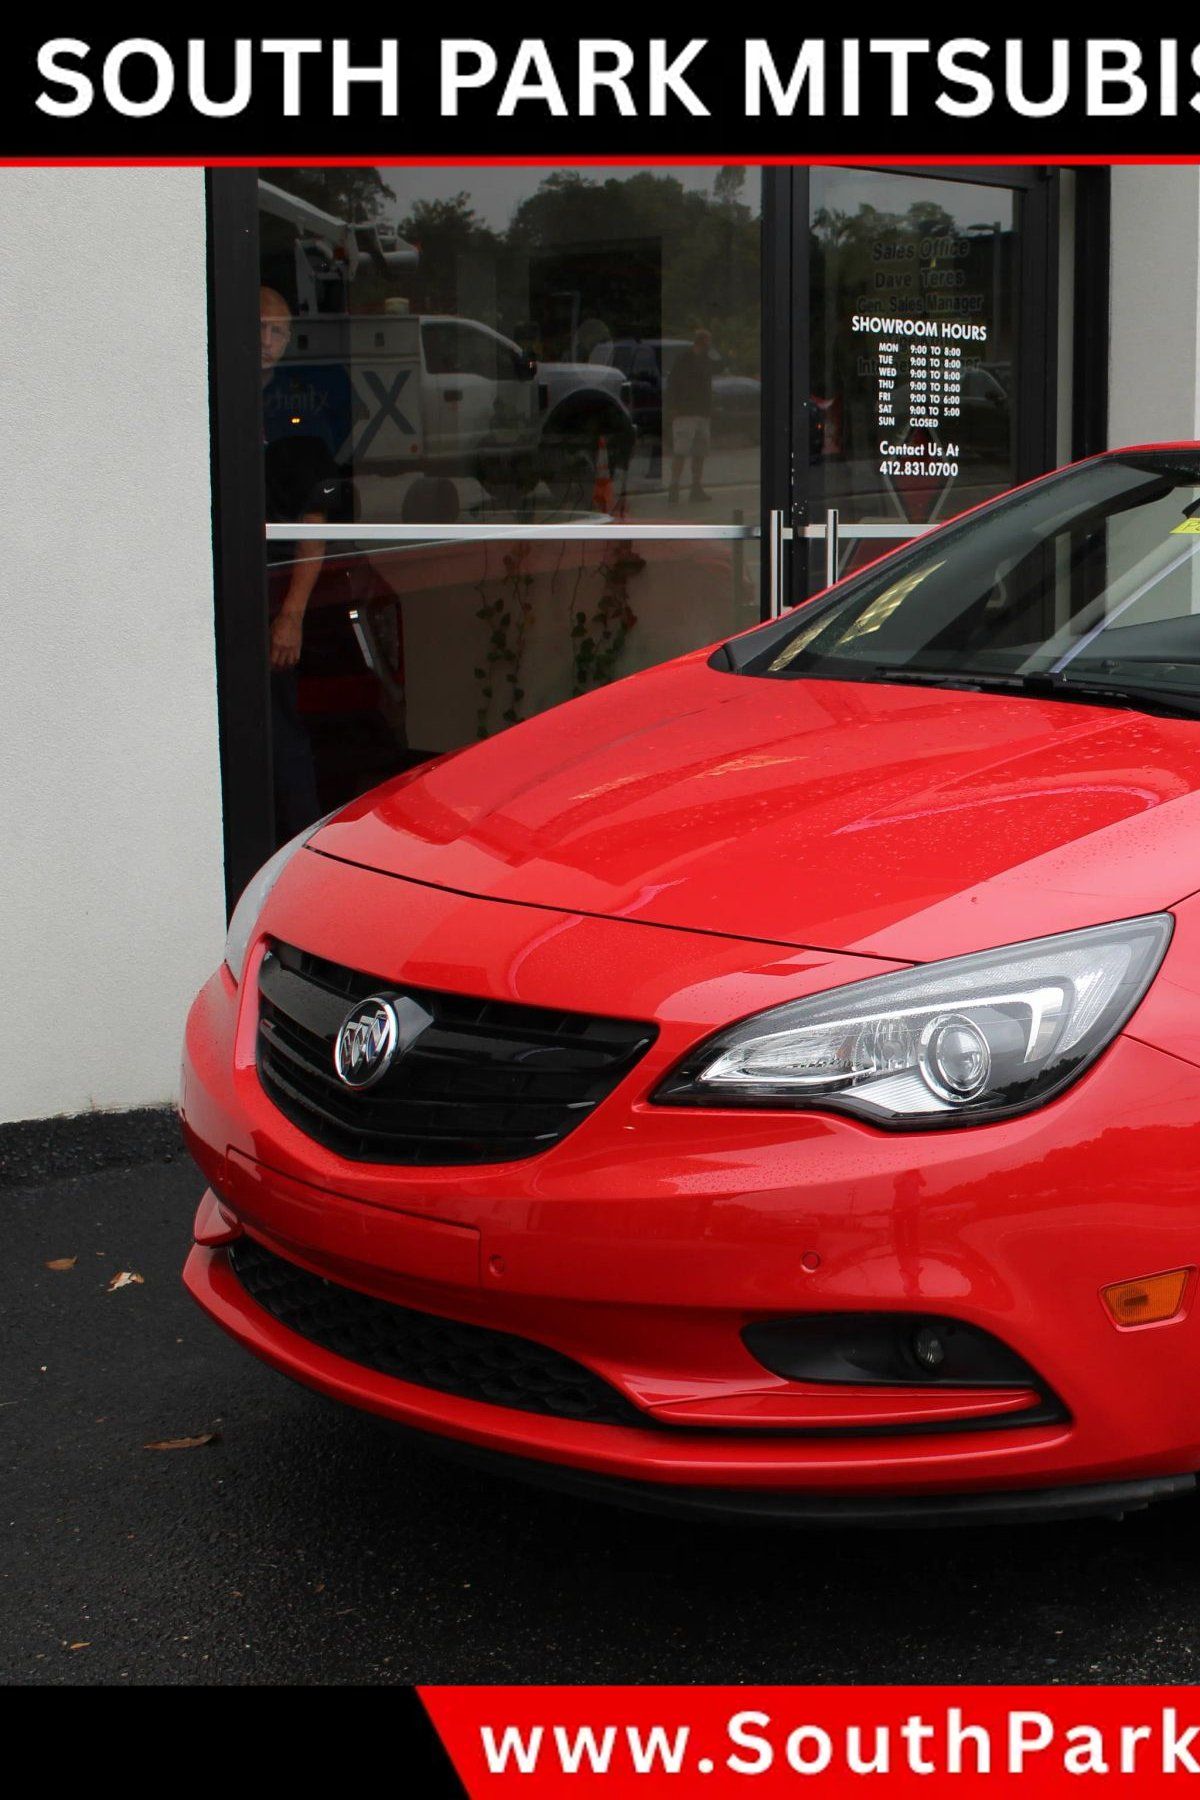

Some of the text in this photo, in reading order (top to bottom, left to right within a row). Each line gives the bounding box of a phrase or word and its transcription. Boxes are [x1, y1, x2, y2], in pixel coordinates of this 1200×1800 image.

[872, 238, 970, 261] Sales Office
[875, 272, 912, 289] Dave
[852, 316, 938, 338] SHOWROOM
[942, 323, 987, 341] HOURS
[879, 343, 961, 357] MON 9:00 TO 8:00
[878, 355, 893, 364] TUE
[910, 357, 926, 367] 9:00
[930, 358, 940, 368] TO
[944, 359, 961, 369] 8:00
[879, 367, 897, 377] WED
[910, 369, 927, 379] 9:00
[930, 370, 941, 380] TO
[943, 371, 961, 381] 8:00
[879, 380, 961, 393] THU 9:00 TO 8:00
[879, 392, 960, 405] FRI 9:00 TO 6:00
[879, 404, 960, 417] SAT 9:00 TO 5:00
[879, 417, 939, 428] SUN CLOSED
[880, 440, 960, 457] Contact Us At
[879, 461, 960, 477] 412.831.0700
